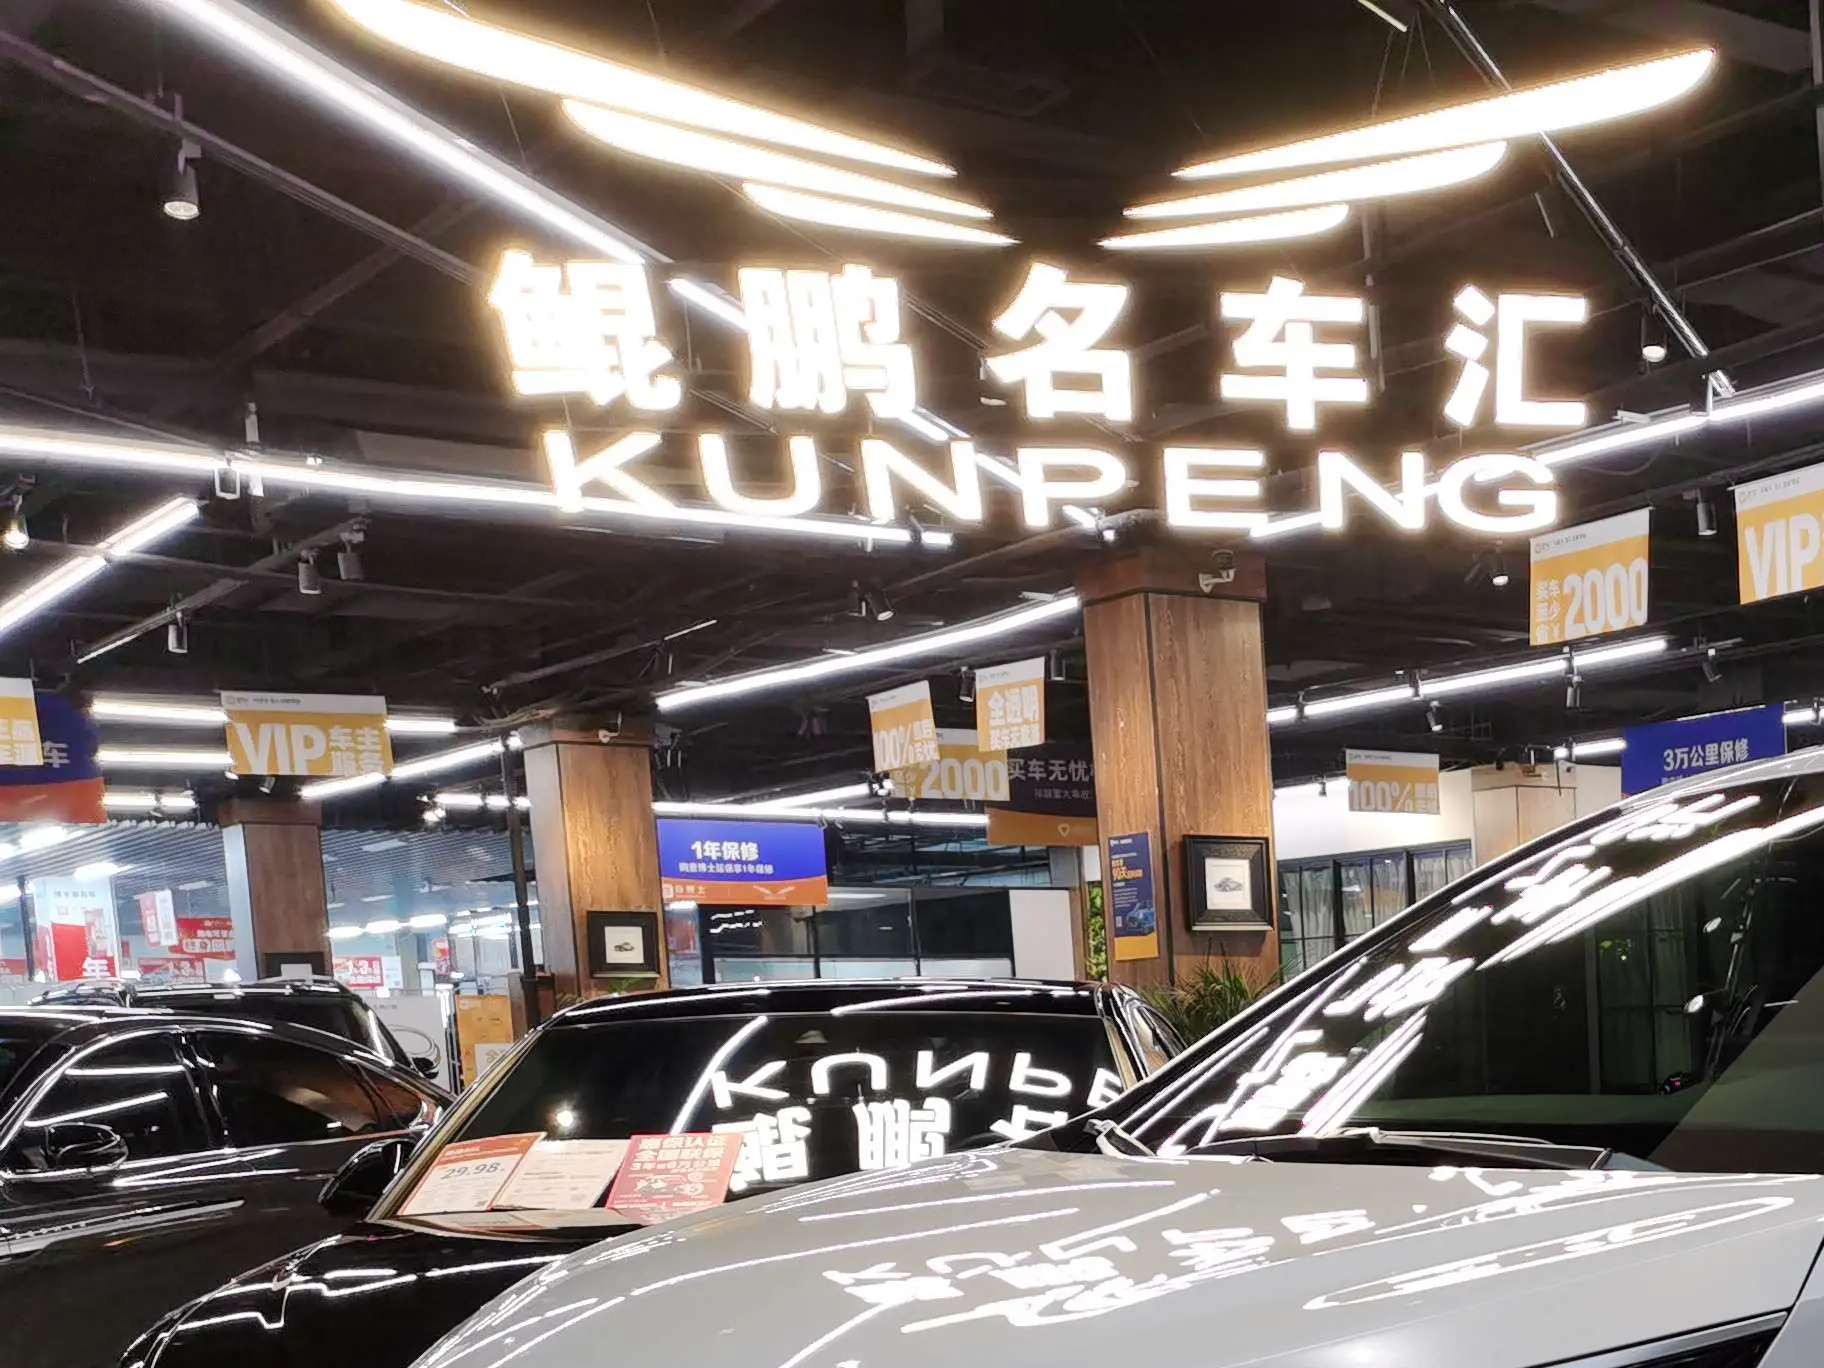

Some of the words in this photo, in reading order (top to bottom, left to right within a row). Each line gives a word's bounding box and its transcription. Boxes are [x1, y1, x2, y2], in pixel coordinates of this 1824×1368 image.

[488, 249, 1588, 430] 鲲鹏名车汇
[543, 430, 1558, 533] KUNPENG
[1745, 513, 1820, 600] VIP
[1563, 557, 1649, 641] 2000
[234, 723, 326, 775] VIP
[1008, 758, 1094, 782] 买车无忧
[1663, 738, 1750, 772] 3万公里保修
[921, 757, 1008, 800] 2000
[690, 840, 759, 861] 1年保修
